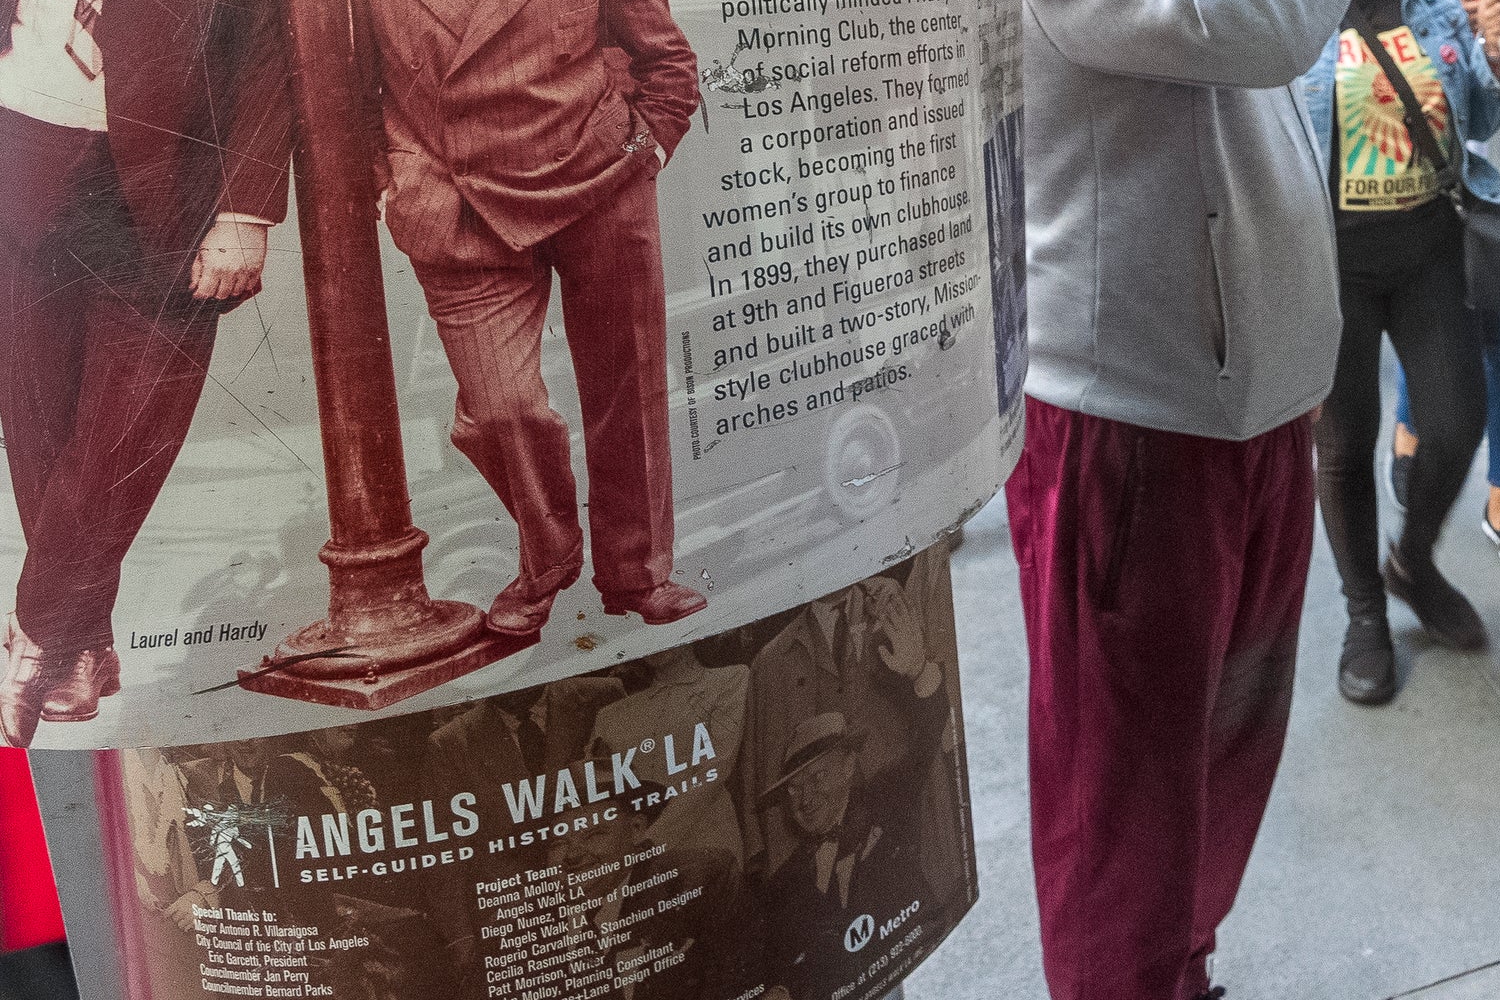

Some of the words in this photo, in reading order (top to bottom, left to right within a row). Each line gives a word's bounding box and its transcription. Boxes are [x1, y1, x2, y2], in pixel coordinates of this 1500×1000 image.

[744, 97, 782, 119] Los
[790, 82, 878, 115] Angeles.
[882, 79, 923, 104] They
[928, 70, 969, 98] formed
[702, 193, 808, 229] women's
[815, 182, 872, 214] group
[877, 176, 895, 197] to
[900, 164, 956, 191] finance
[1345, 179, 1378, 194] FOR
[709, 274, 732, 298] In
[741, 263, 798, 293] 1899,
[804, 253, 850, 279] they
[856, 229, 945, 267] purchased
[948, 214, 973, 240] land
[712, 310, 735, 332] at
[742, 300, 777, 325] 9th
[786, 288, 826, 316] and
[833, 268, 913, 306] Figueroa
[919, 249, 965, 280] streets
[682, 331, 693, 374] PRODUCTIONS
[688, 397, 695, 405] OF
[689, 407, 699, 438] COURTESY
[692, 440, 701, 460] PHOTO
[131, 629, 178, 649] Laurel
[184, 625, 213, 645] and
[219, 620, 268, 641] Hardy
[295, 791, 480, 859] ANGELS
[664, 722, 717, 777] LA
[300, 846, 474, 883] SELF-GUIDED
[488, 806, 619, 854] HISTORIC
[631, 767, 720, 811] TRAILS
[476, 873, 521, 894] Project
[525, 865, 563, 882] Team:
[478, 890, 520, 910] Deanna
[524, 879, 564, 898] Molloy,
[567, 861, 620, 886] Executive
[623, 843, 667, 867] Director
[192, 904, 223, 919] Special
[225, 908, 260, 922] Thanks
[262, 911, 277, 922] to:
[481, 921, 513, 939] Diego
[517, 912, 555, 929] Nunez,
[559, 898, 602, 918] Director
[607, 889, 618, 903] of
[622, 869, 679, 898] Operations
[496, 902, 534, 921] Angels
[538, 893, 566, 910] Walk
[569, 886, 585, 901] LA
[880, 900, 920, 940] Metro
[195, 919, 217, 934] Mayor
[219, 924, 250, 936] Antonio
[253, 926, 262, 937] R.
[265, 925, 318, 938] Villaraigosa
[484, 950, 527, 968] Rogerio
[532, 930, 597, 955] Carvalheiro,
[600, 907, 655, 934] Stanchion
[658, 886, 704, 912] Designer
[200, 964, 261, 982] Councilmember
[264, 971, 281, 982] Jan
[284, 971, 309, 984] Perry
[208, 951, 224, 963] Eric
[226, 953, 262, 967] Garcetti,
[264, 955, 308, 967] President
[202, 978, 262, 996] Councilmember
[265, 985, 302, 997] Bernard
[305, 984, 333, 995] Parks
